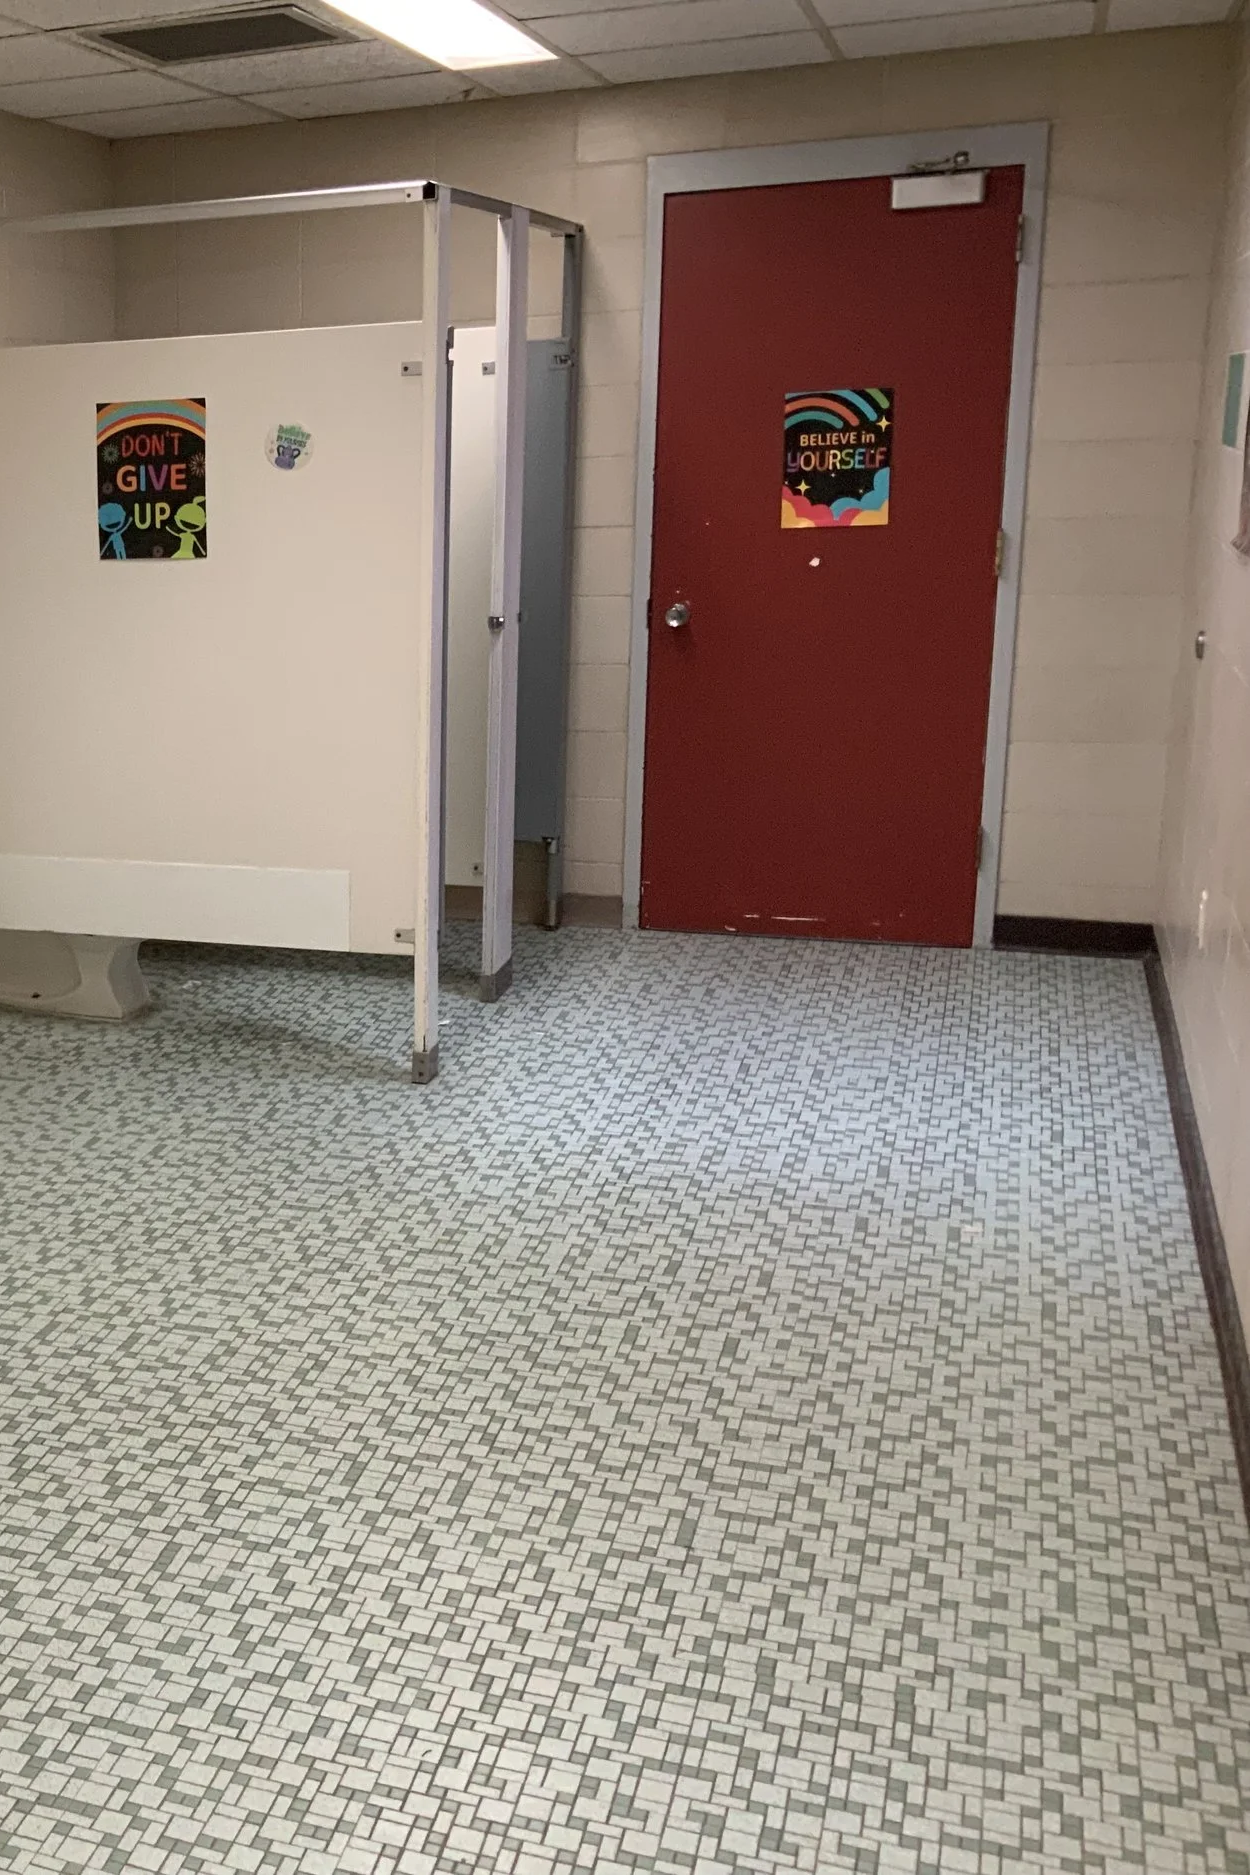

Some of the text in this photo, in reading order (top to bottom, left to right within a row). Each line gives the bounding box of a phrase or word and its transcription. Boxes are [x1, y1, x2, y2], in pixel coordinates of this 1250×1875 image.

[121, 431, 182, 457] DON'T
[799, 431, 875, 447] BELIEVE in
[787, 447, 887, 473] YOURSELF
[116, 463, 187, 492] GIVE
[134, 502, 171, 529] UP
